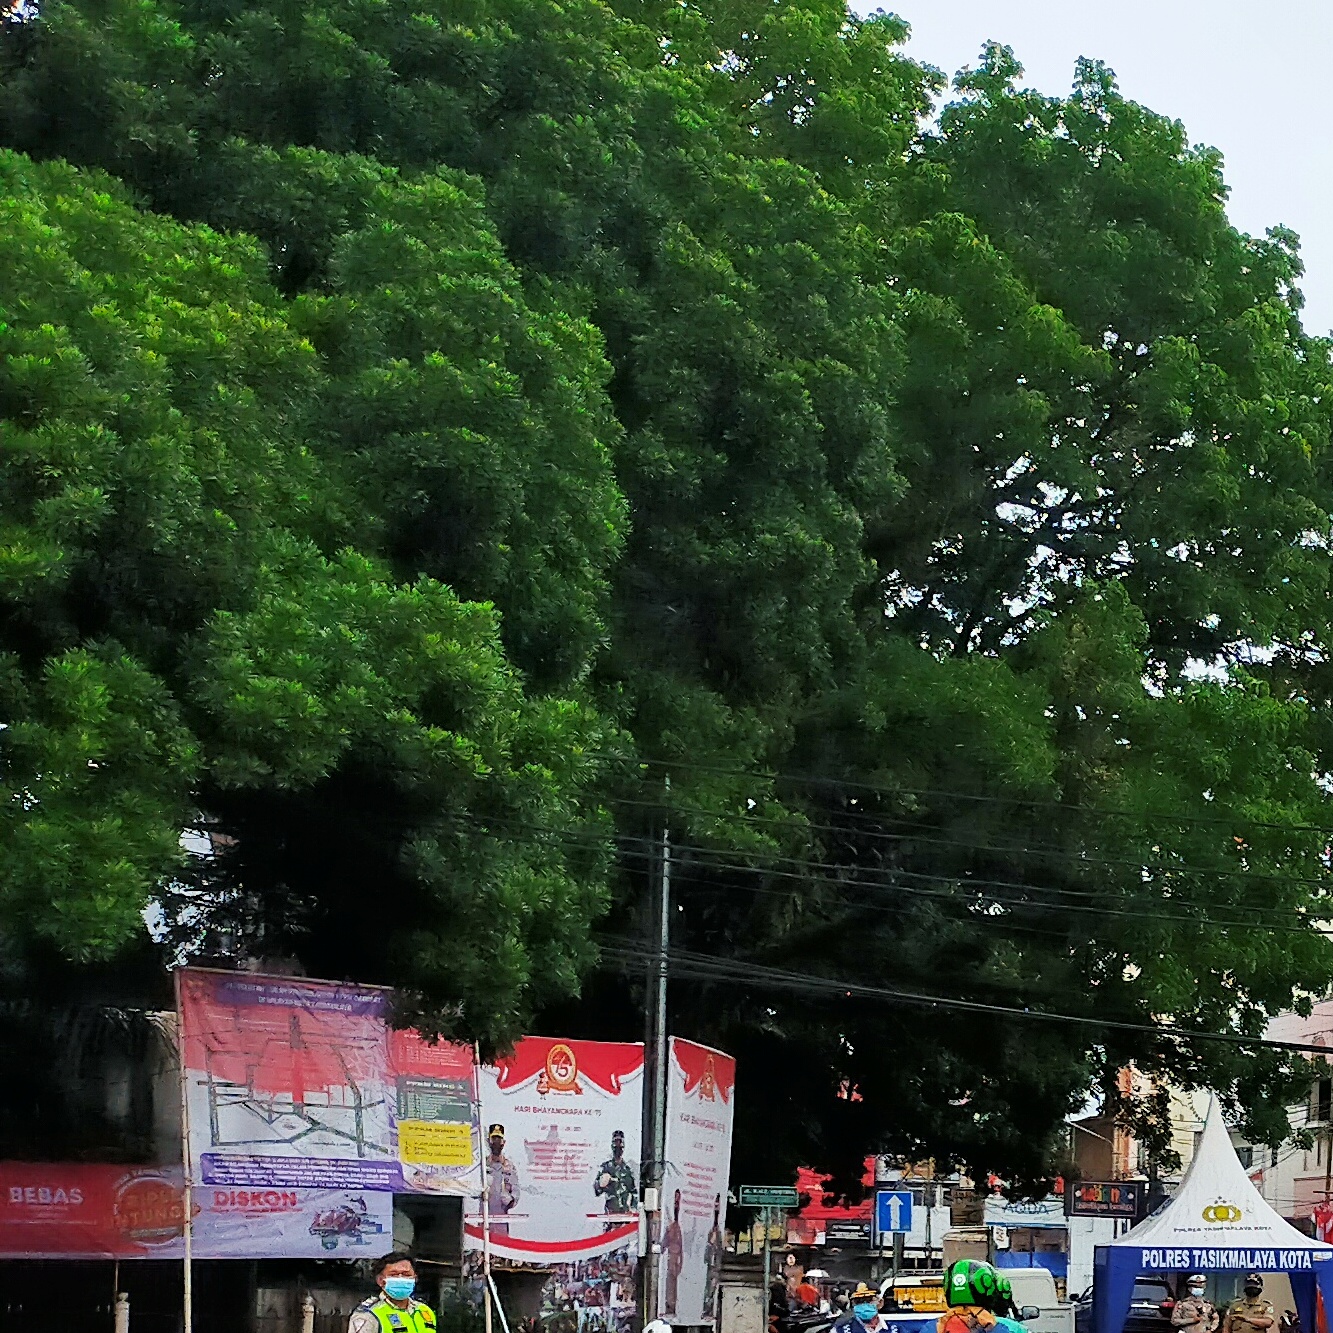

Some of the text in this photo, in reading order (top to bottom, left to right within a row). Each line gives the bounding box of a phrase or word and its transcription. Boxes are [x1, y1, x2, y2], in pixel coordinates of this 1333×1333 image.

[9, 1186, 84, 1204] BEBAS
[213, 1190, 298, 1207] DISKON
[1142, 1249, 1312, 1269] POLRES TASIKMALAYA KOTA
